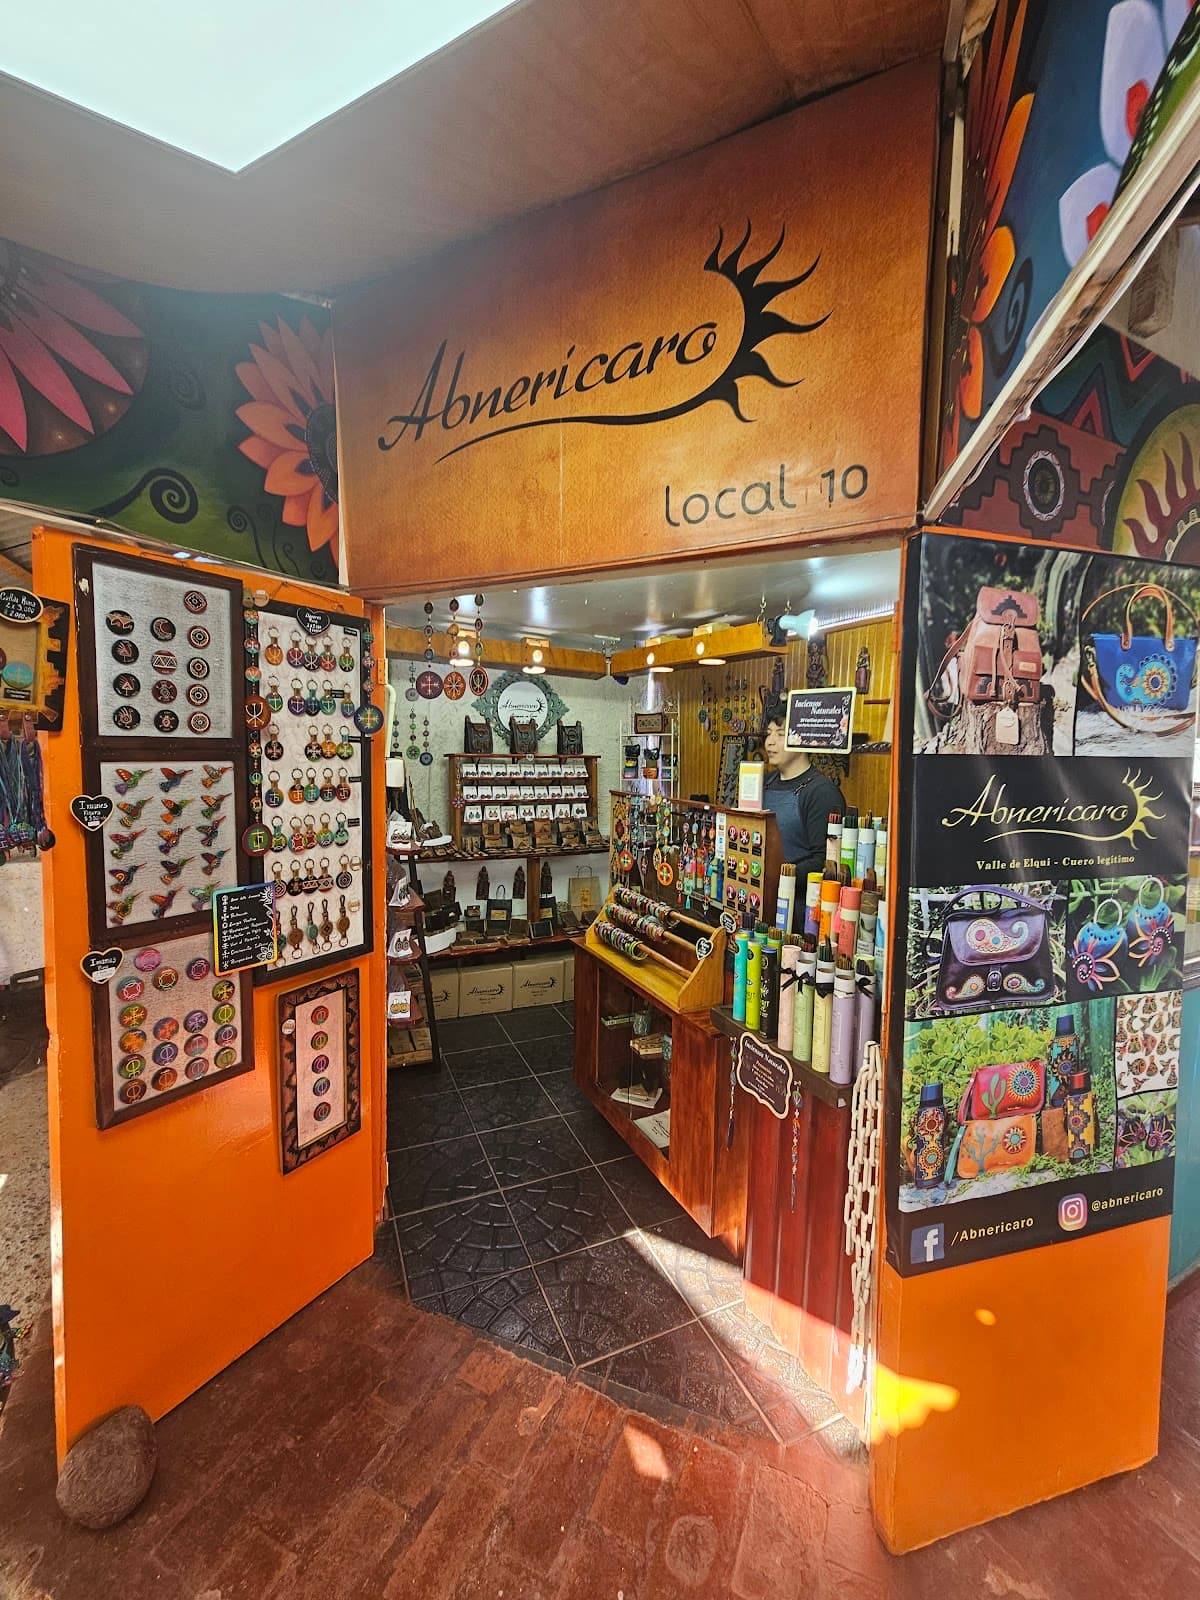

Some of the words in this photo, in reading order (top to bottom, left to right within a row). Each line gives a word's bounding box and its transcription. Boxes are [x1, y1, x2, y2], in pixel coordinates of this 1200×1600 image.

[378, 321, 717, 451] Abnericaro
[665, 463, 797, 527] local
[821, 464, 869, 503] 10
[941, 774, 1128, 827] Abnericaro
[976, 860, 1006, 870] Valle
[1009, 859, 1020, 869] de
[1024, 857, 1050, 869] Elqui
[1062, 857, 1094, 866] Cuero
[1091, 1187, 1163, 1212] @abnericaro
[951, 1218, 1034, 1246] /Abnericaro
